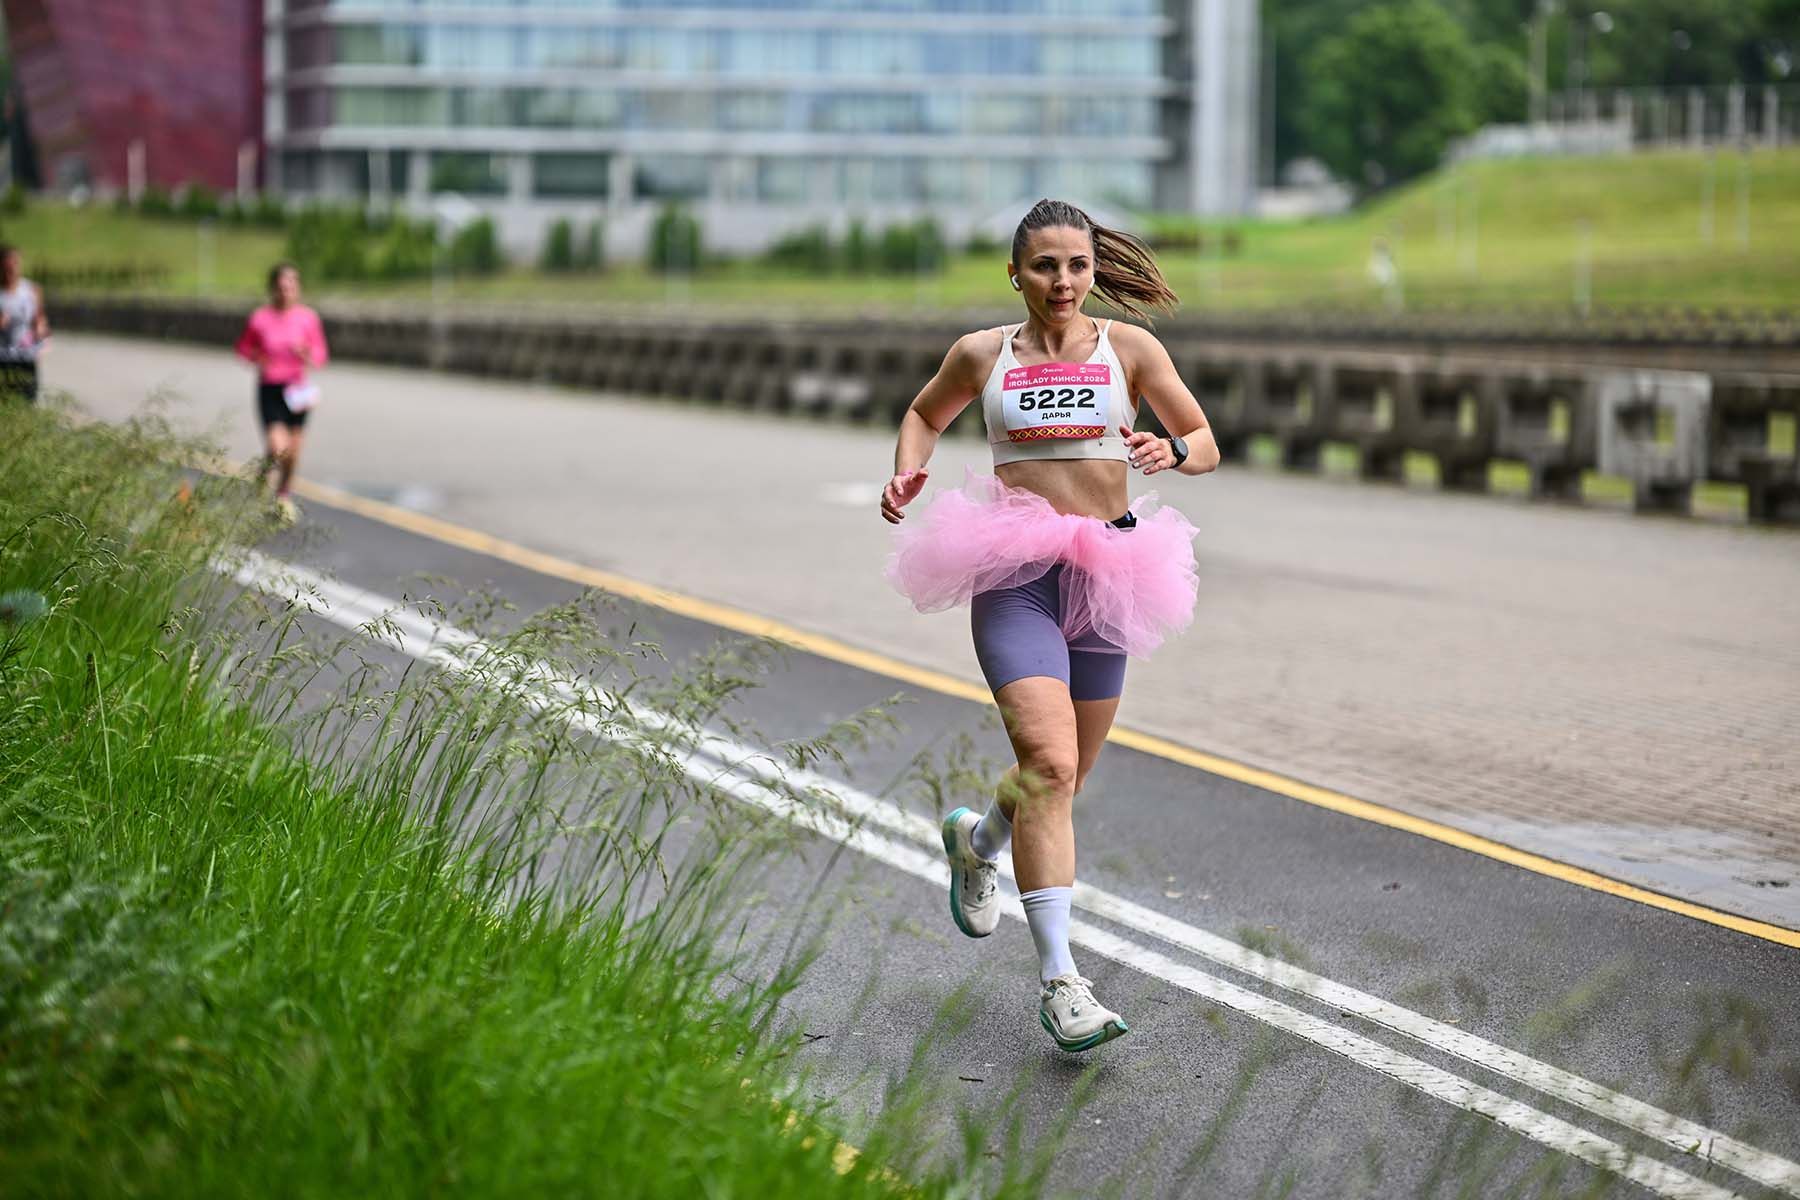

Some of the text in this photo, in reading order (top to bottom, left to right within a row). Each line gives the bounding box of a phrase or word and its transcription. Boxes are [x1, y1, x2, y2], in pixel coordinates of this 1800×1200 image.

[1008, 375, 1106, 388] IRONLADY МИНСК 2026
[1019, 388, 1095, 411] 5222
[1041, 411, 1071, 420] ДАРЬЯ
